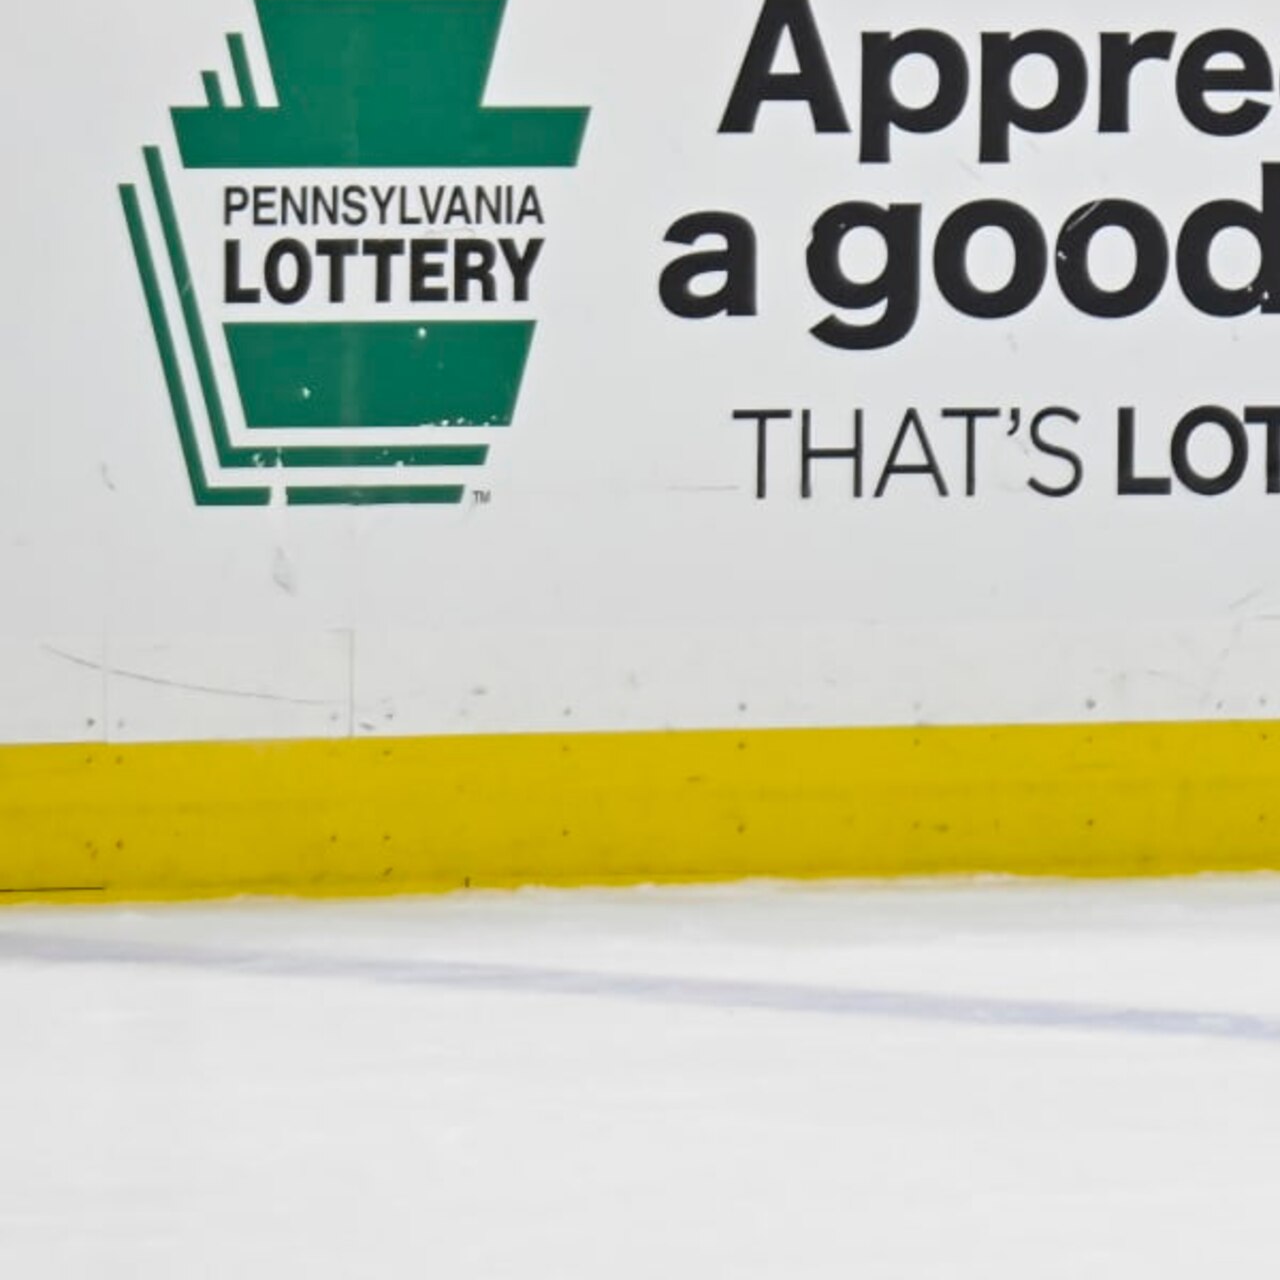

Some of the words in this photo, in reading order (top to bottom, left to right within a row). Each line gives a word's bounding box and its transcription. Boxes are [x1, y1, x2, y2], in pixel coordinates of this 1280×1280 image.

[223, 185, 545, 226] PENNSYLVANIA
[223, 237, 545, 306] LOTTERY
[658, 210, 757, 320] a
